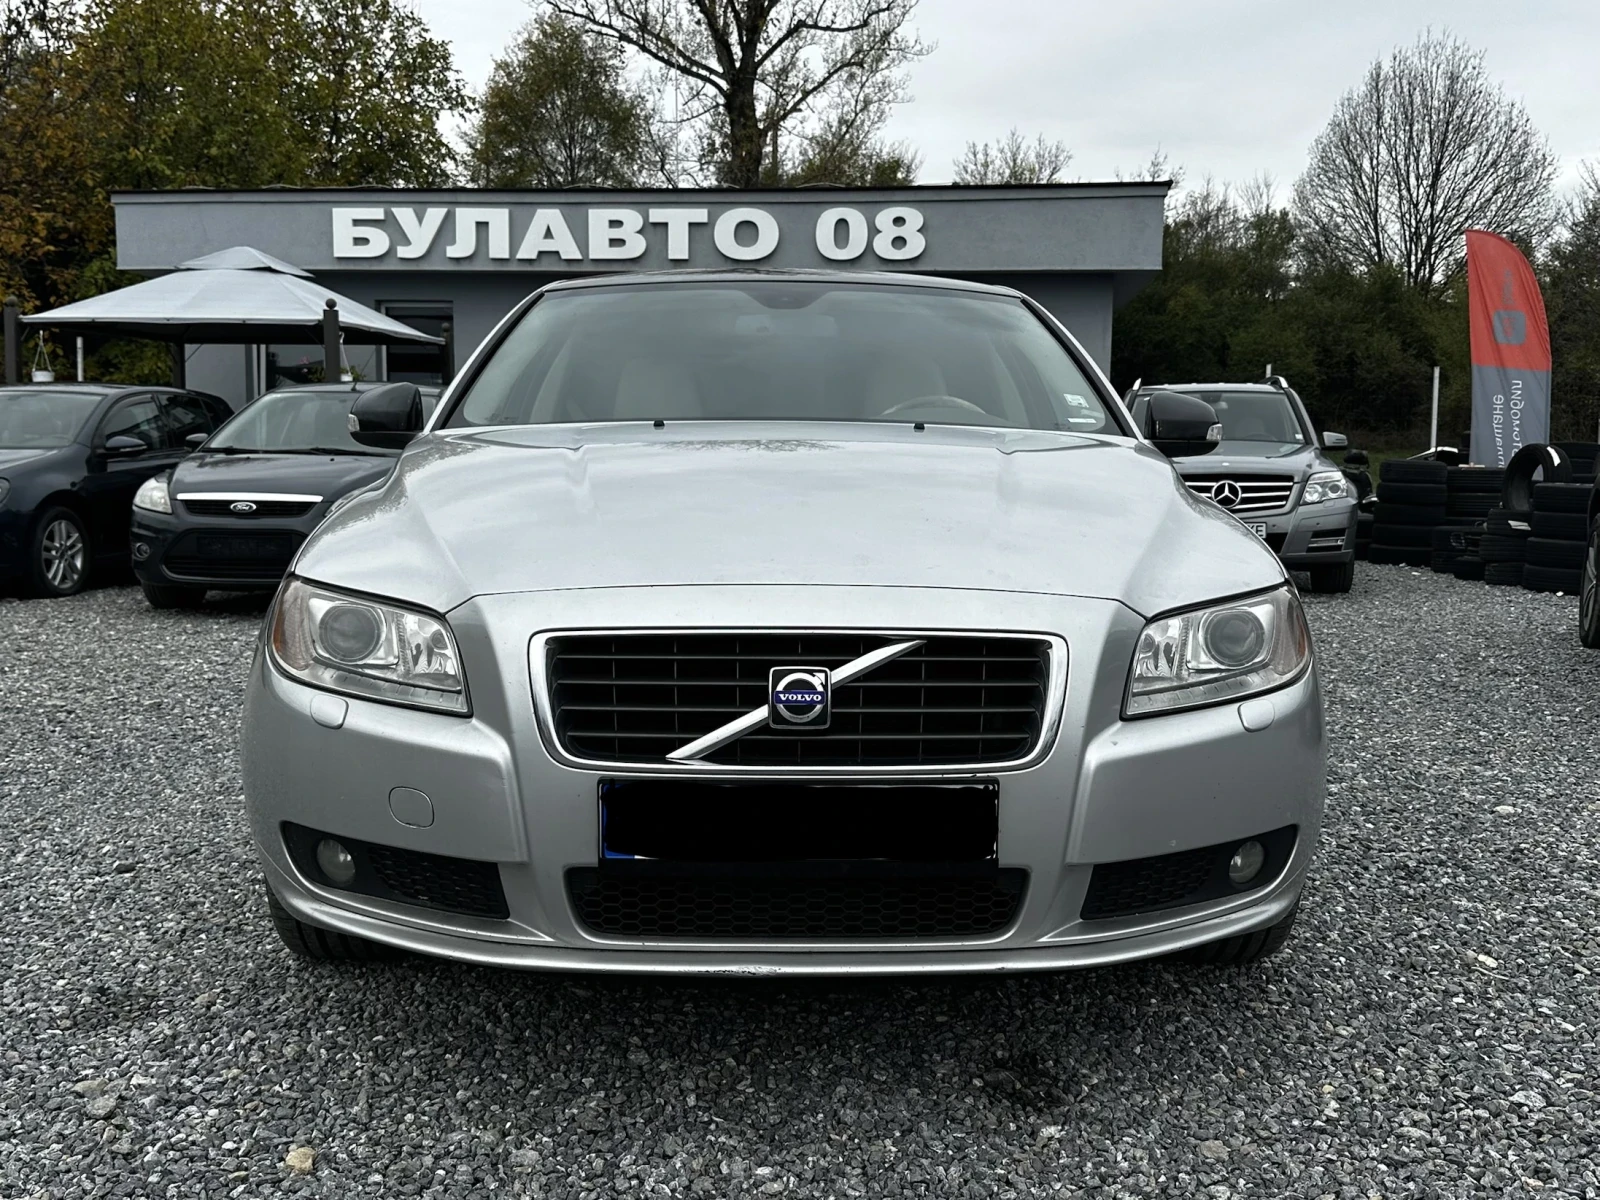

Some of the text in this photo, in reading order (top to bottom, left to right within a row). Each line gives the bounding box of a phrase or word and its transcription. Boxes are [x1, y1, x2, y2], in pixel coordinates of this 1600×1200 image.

[332, 207, 926, 260] БУЛАВТО 08
[778, 693, 822, 702] VOLVO
